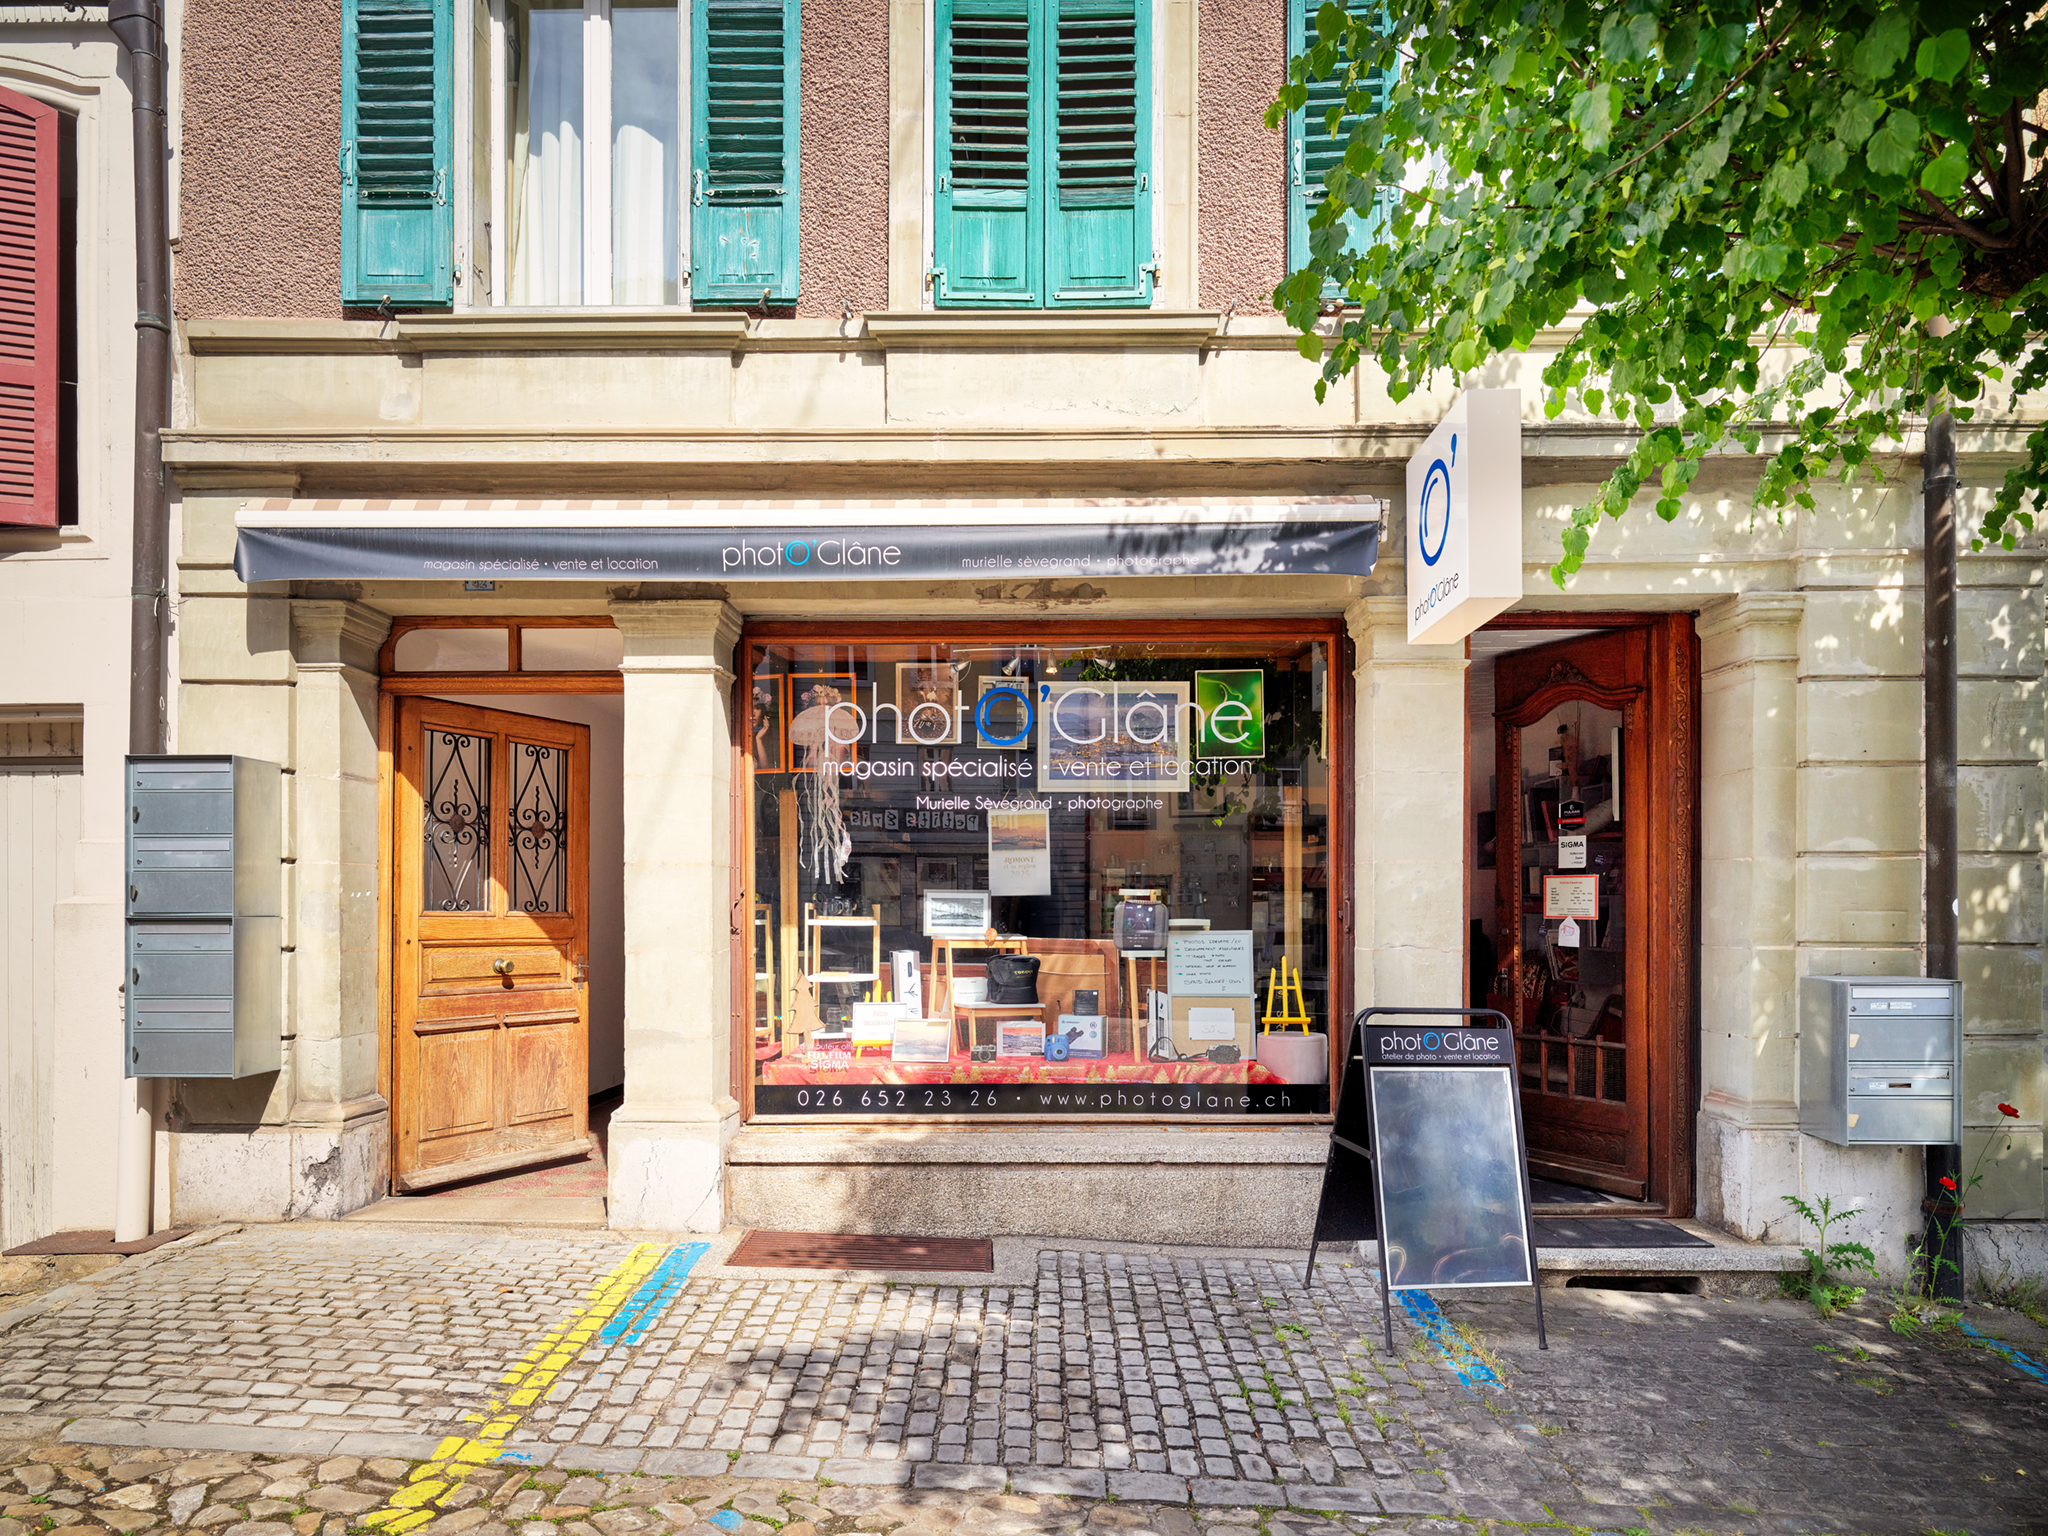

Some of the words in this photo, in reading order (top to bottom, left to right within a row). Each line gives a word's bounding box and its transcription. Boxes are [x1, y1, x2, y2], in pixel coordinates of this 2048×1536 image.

[722, 538, 902, 572] photO'Glâne
[961, 554, 1013, 568] murielle
[1017, 554, 1091, 570] sèvegrand
[1107, 554, 1200, 568] photographe
[423, 559, 475, 572] magasin
[478, 557, 540, 572] spécialisé
[552, 558, 587, 571] vente
[590, 559, 604, 570] et
[606, 557, 659, 570] location
[1414, 572, 1459, 627] photO'Glâne
[824, 681, 1253, 758] photO'Glâne
[822, 757, 915, 780] magasin
[922, 755, 1033, 781] spécialisé
[1058, 756, 1122, 777] vente
[1129, 756, 1152, 776] et
[1160, 754, 1252, 776] location
[916, 796, 970, 810] Murielle
[974, 795, 1053, 812] Sèvegrand
[1068, 795, 1164, 812] photographe
[1003, 856, 1035, 864] ROMONT
[1380, 1030, 1499, 1054] photO'Glâne
[810, 1060, 850, 1069] SIGMA
[1381, 1052, 1403, 1060] atelier
[1404, 1052, 1415, 1060] de
[1416, 1052, 1437, 1061] photo
[1472, 1052, 1501, 1060] location
[797, 1090, 843, 1106] 026
[861, 1090, 905, 1106] 652
[924, 1090, 952, 1106] 23
[970, 1090, 997, 1106] 26
